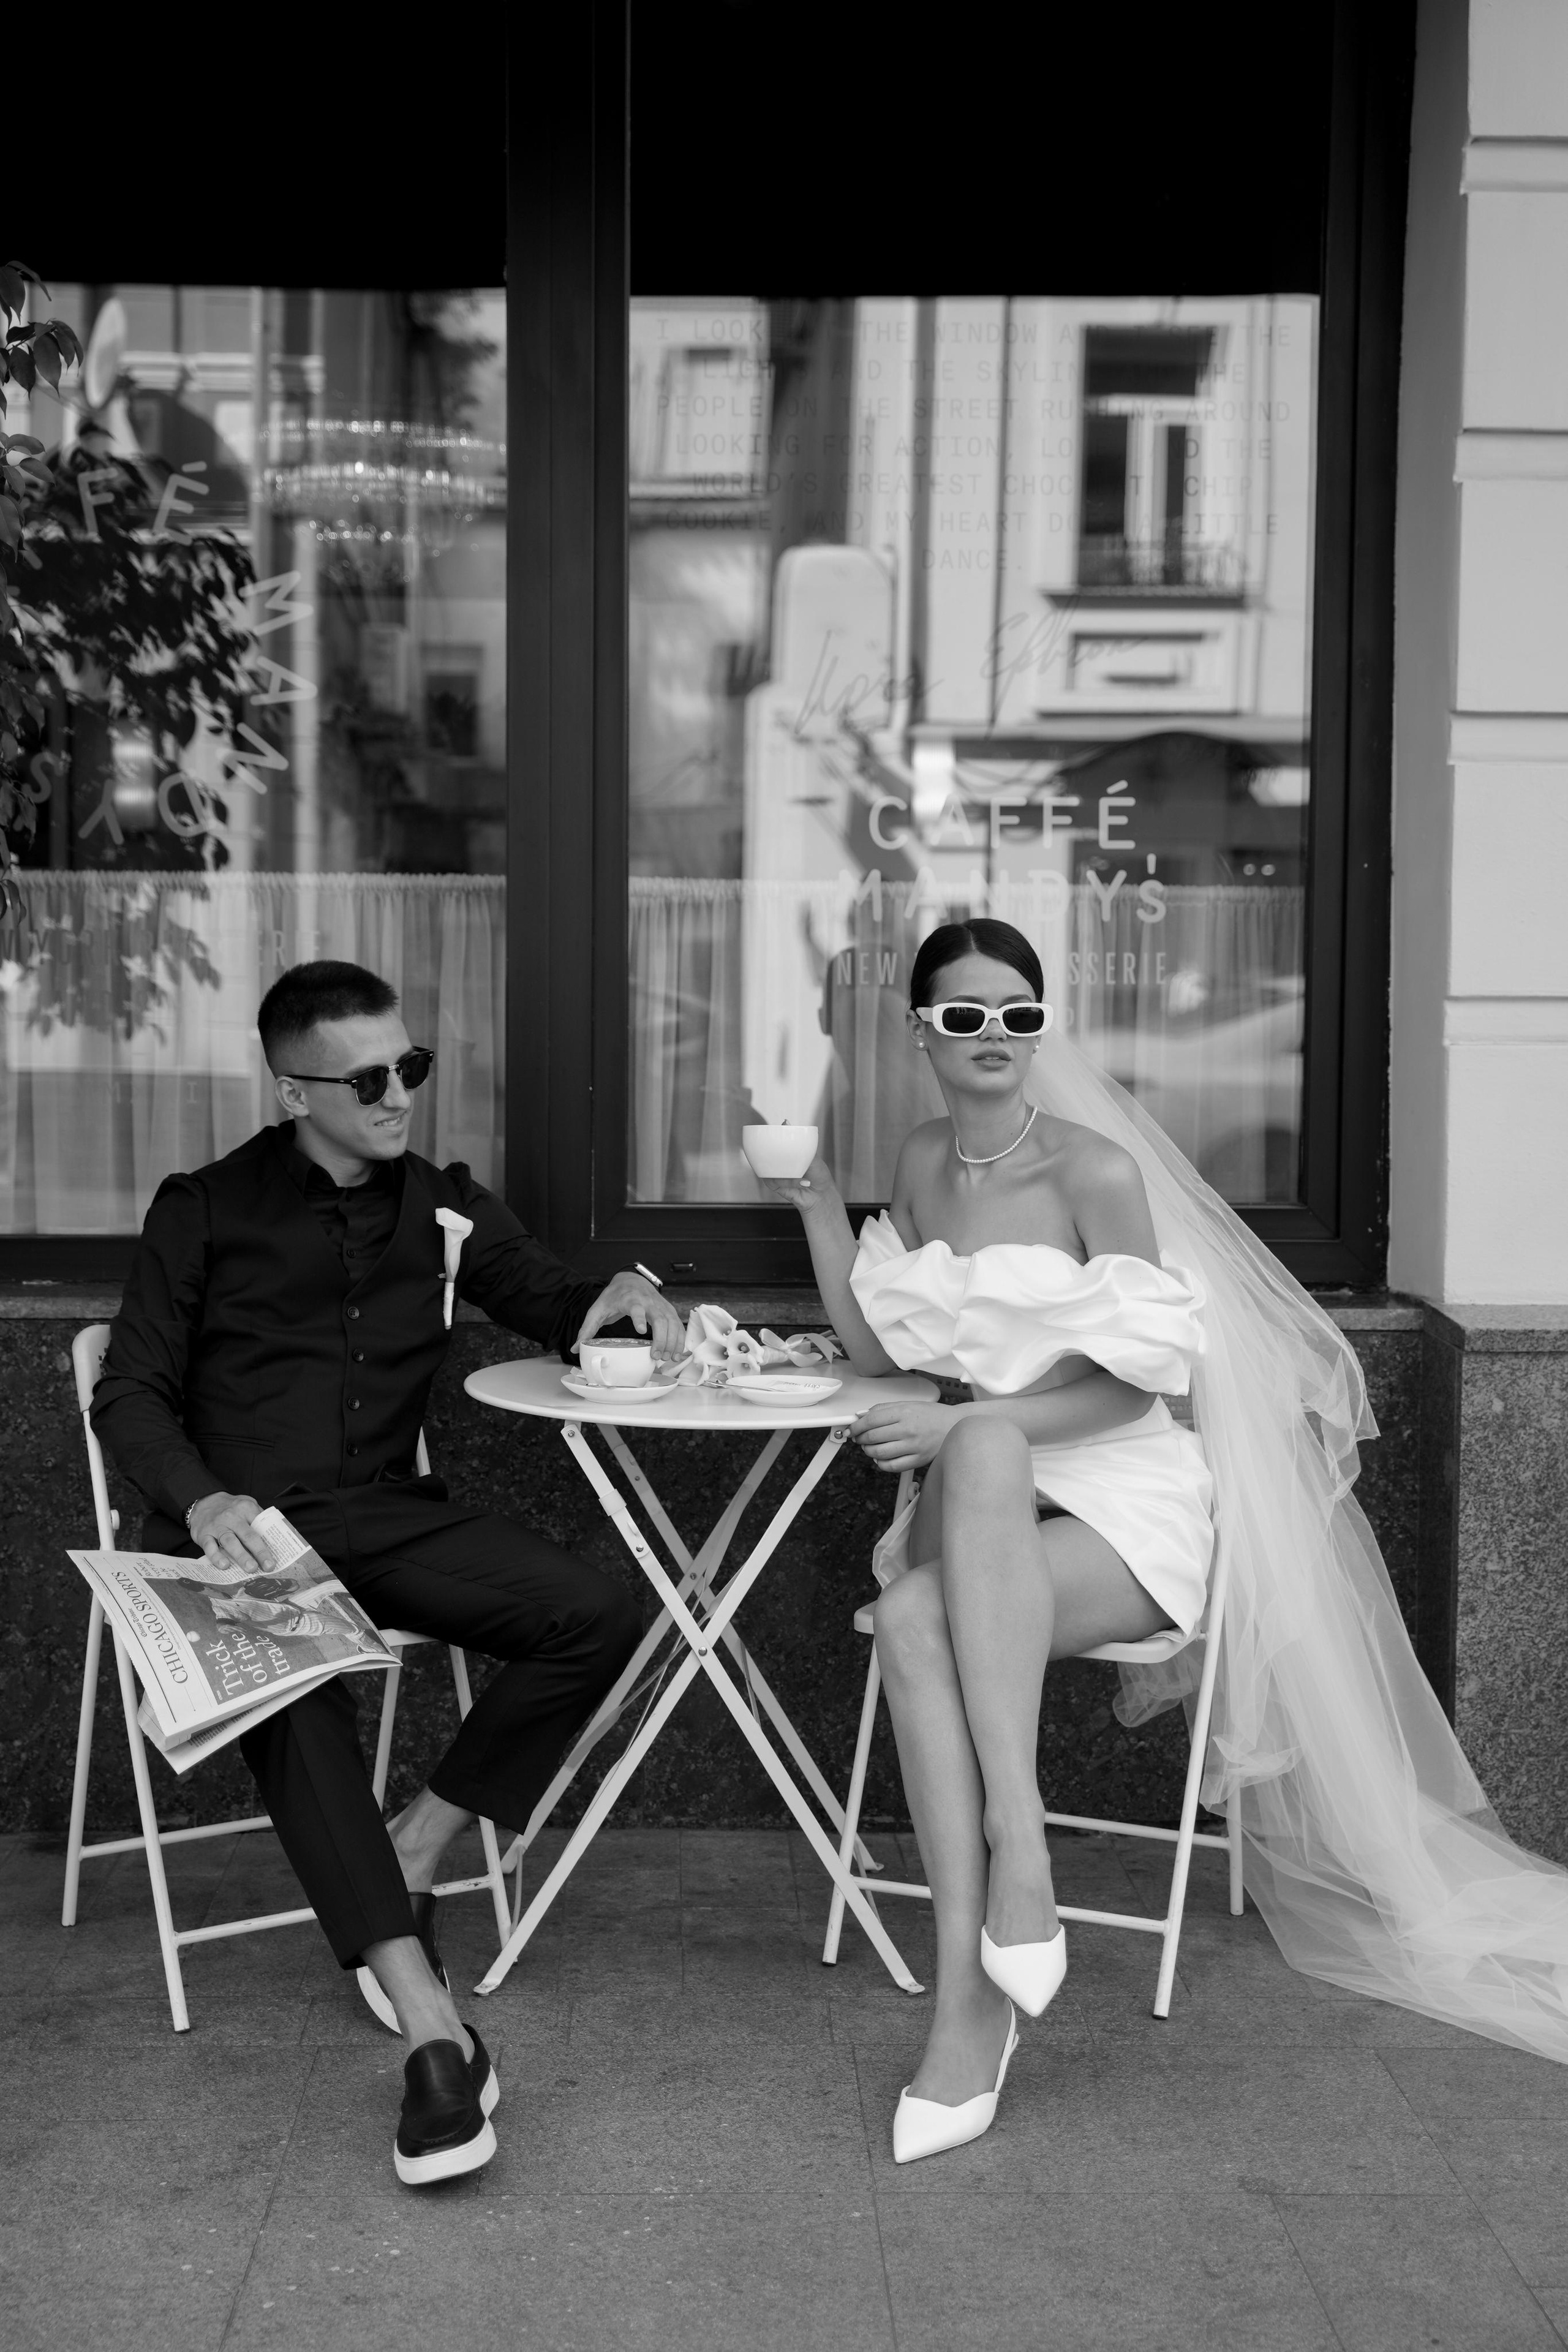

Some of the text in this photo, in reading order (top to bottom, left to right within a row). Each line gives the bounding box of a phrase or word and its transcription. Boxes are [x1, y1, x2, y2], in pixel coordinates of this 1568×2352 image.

[657, 319, 669, 341] I
[694, 319, 763, 342] LOOK
[861, 321, 908, 342] THE
[1243, 325, 1292, 347] THE
[907, 361, 956, 382] THE
[1196, 363, 1246, 384] THE
[656, 395, 763, 418] PEOPLE
[843, 397, 891, 419] THE
[913, 398, 1019, 420] STREET
[1185, 400, 1291, 422] AROUND
[676, 434, 801, 456] LOOKING
[823, 434, 874, 456] FOR
[894, 435, 1014, 459] ACTION,
[1221, 439, 1273, 461] THE
[839, 472, 983, 496] GREATEST
[1183, 475, 1253, 498] CHIP
[812, 511, 865, 533] AND
[884, 511, 917, 533] MY
[939, 511, 1028, 534] HEART
[922, 549, 1023, 571] DANCE.
[868, 779, 1137, 851] CAFFÉ
[836, 952, 898, 986] NEW
[111, 1571, 153, 1612] SPORTS
[142, 1612, 189, 1684] CHICAGO
[231, 1632, 268, 1684] of the
[254, 1635, 291, 1675] trade
[205, 1639, 244, 1696] Trick
